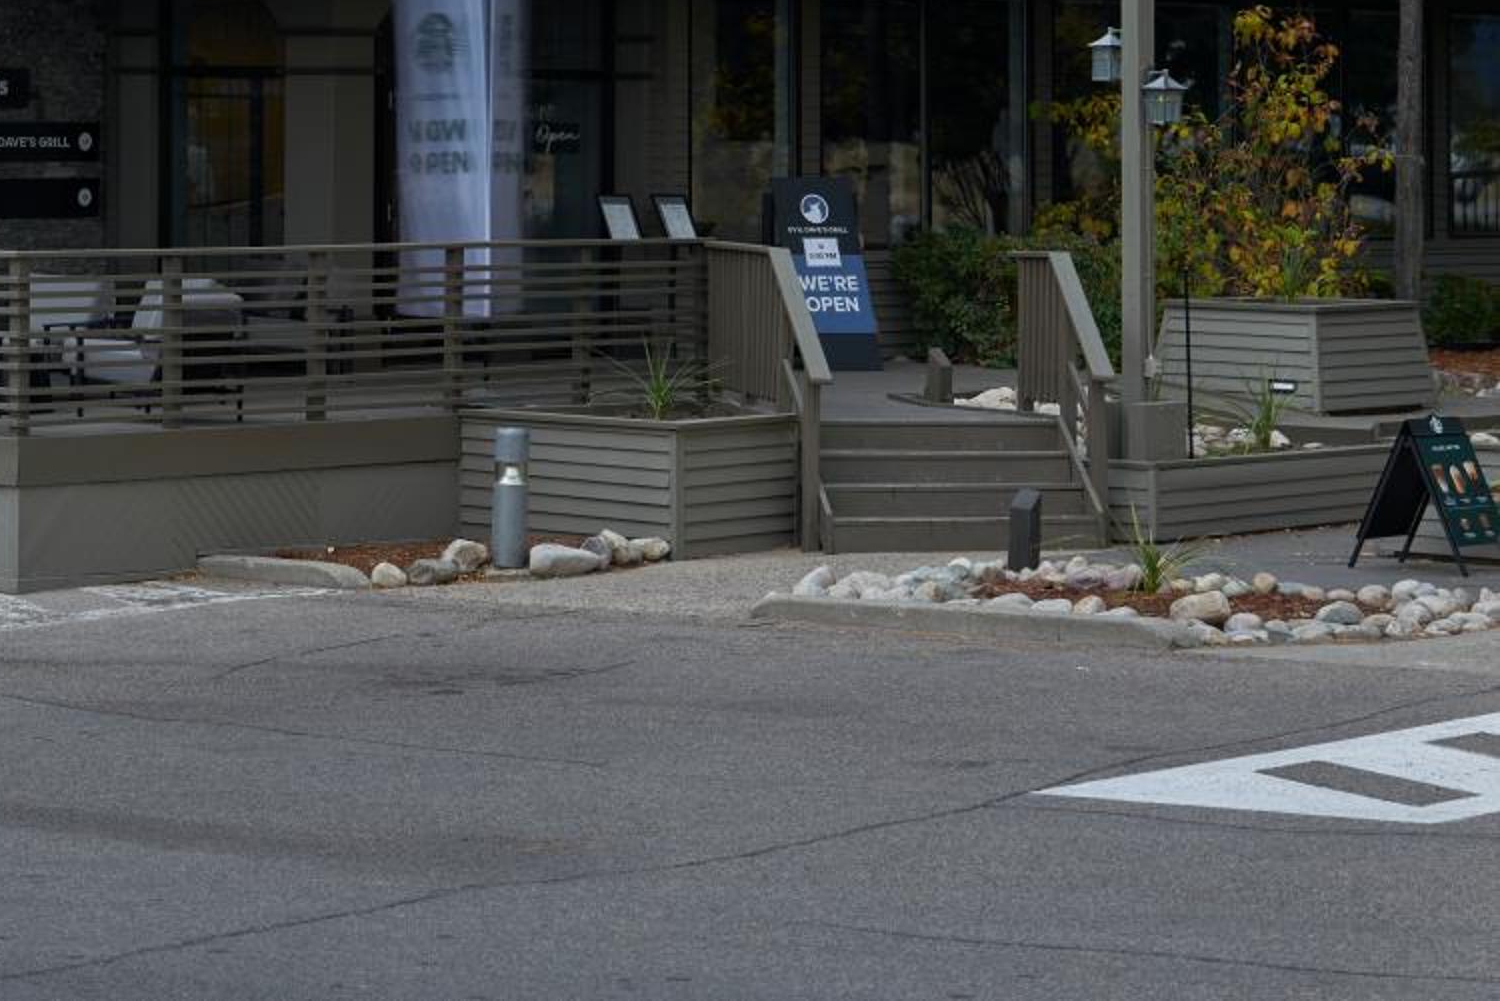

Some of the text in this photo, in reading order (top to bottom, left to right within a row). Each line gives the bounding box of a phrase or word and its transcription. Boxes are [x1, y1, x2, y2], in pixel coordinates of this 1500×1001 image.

[38, 135, 71, 148] GRILL
[798, 275, 860, 292] WE'RE
[805, 296, 860, 312] OPEN
